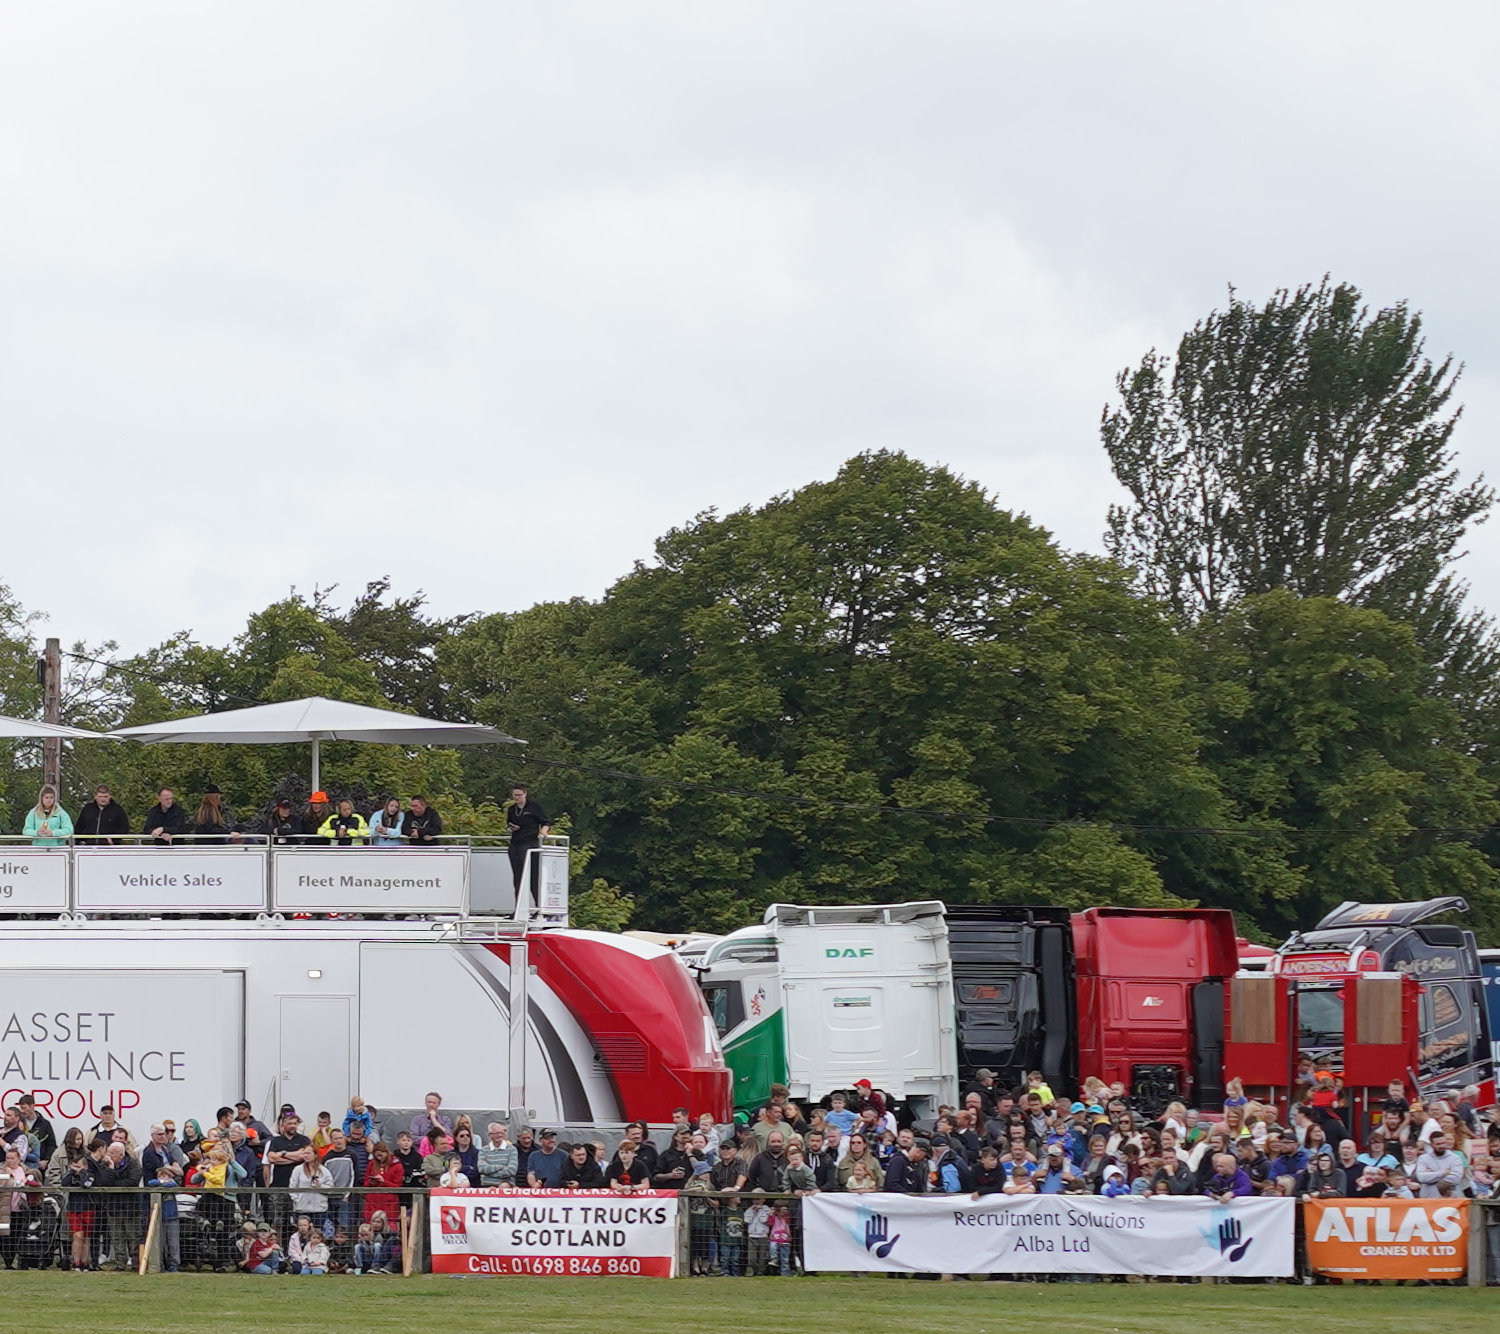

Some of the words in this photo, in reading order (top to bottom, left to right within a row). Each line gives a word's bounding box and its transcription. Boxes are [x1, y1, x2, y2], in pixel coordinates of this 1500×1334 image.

[119, 873, 178, 888] Vehicle
[183, 873, 224, 888] Sales
[299, 874, 333, 888] Fleet
[339, 874, 442, 890] Management
[825, 948, 874, 958] DAF
[1283, 960, 1350, 973] ANDERSON
[1, 1012, 115, 1042] ASSET
[1, 1050, 186, 1081] ALLIANCE
[0, 1089, 140, 1119] GROUP
[473, 1207, 573, 1224] RENAULT
[581, 1207, 667, 1224] TRUCKS
[953, 1210, 1061, 1227] Recruitment
[1067, 1210, 1146, 1229] Solutions
[1313, 1207, 1463, 1242] ATLAS
[511, 1230, 626, 1247] SCOTLAND
[1013, 1235, 1055, 1253] Alba
[1062, 1235, 1091, 1253] Ltd
[1359, 1245, 1408, 1256] CRANES
[1411, 1245, 1430, 1256] UK
[1432, 1245, 1457, 1256] LTD
[468, 1255, 507, 1273] Call:
[513, 1258, 564, 1274] 01698
[569, 1258, 602, 1274] 846
[607, 1258, 640, 1274] 860
